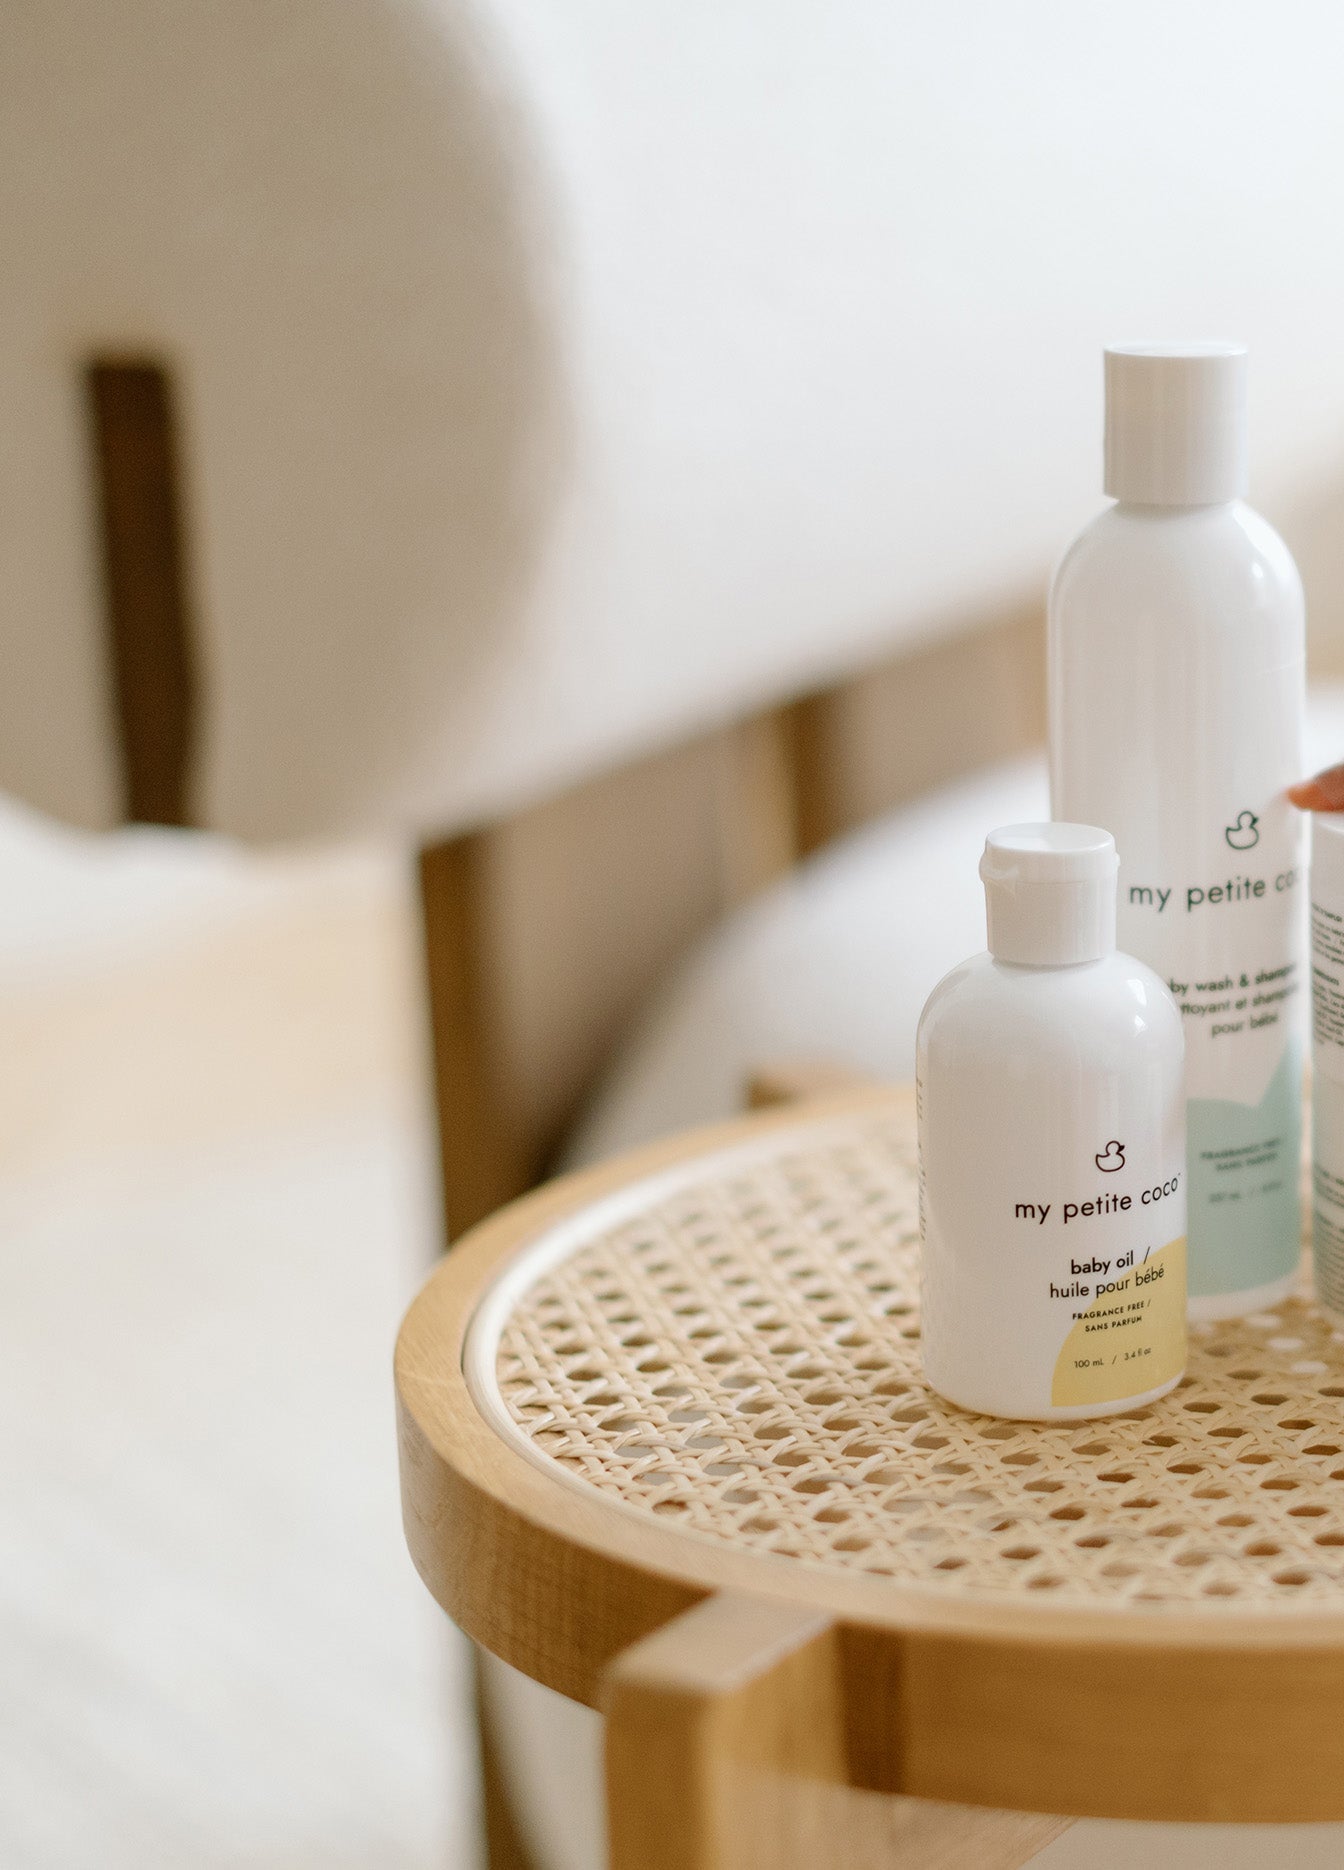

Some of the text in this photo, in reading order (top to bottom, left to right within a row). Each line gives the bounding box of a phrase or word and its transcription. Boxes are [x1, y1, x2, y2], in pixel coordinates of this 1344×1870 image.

[1129, 869, 1300, 912] my petite co
[1168, 978, 1189, 996] by
[1195, 975, 1234, 992] wash
[1239, 973, 1249, 987] &
[1211, 1022, 1244, 1038] pour
[1015, 1203, 1051, 1225] my
[1063, 1193, 1132, 1224] petite
[1141, 1177, 1179, 1205] coco
[1071, 1257, 1111, 1275] baby
[1116, 1250, 1134, 1268] oil
[1050, 1263, 1165, 1299] huile pour bébé
[1072, 1307, 1124, 1320] FRAGRANCE
[1127, 1300, 1145, 1311] FREE
[1085, 1315, 1142, 1332] SANS PARFUM
[1074, 1359, 1090, 1368] 100
